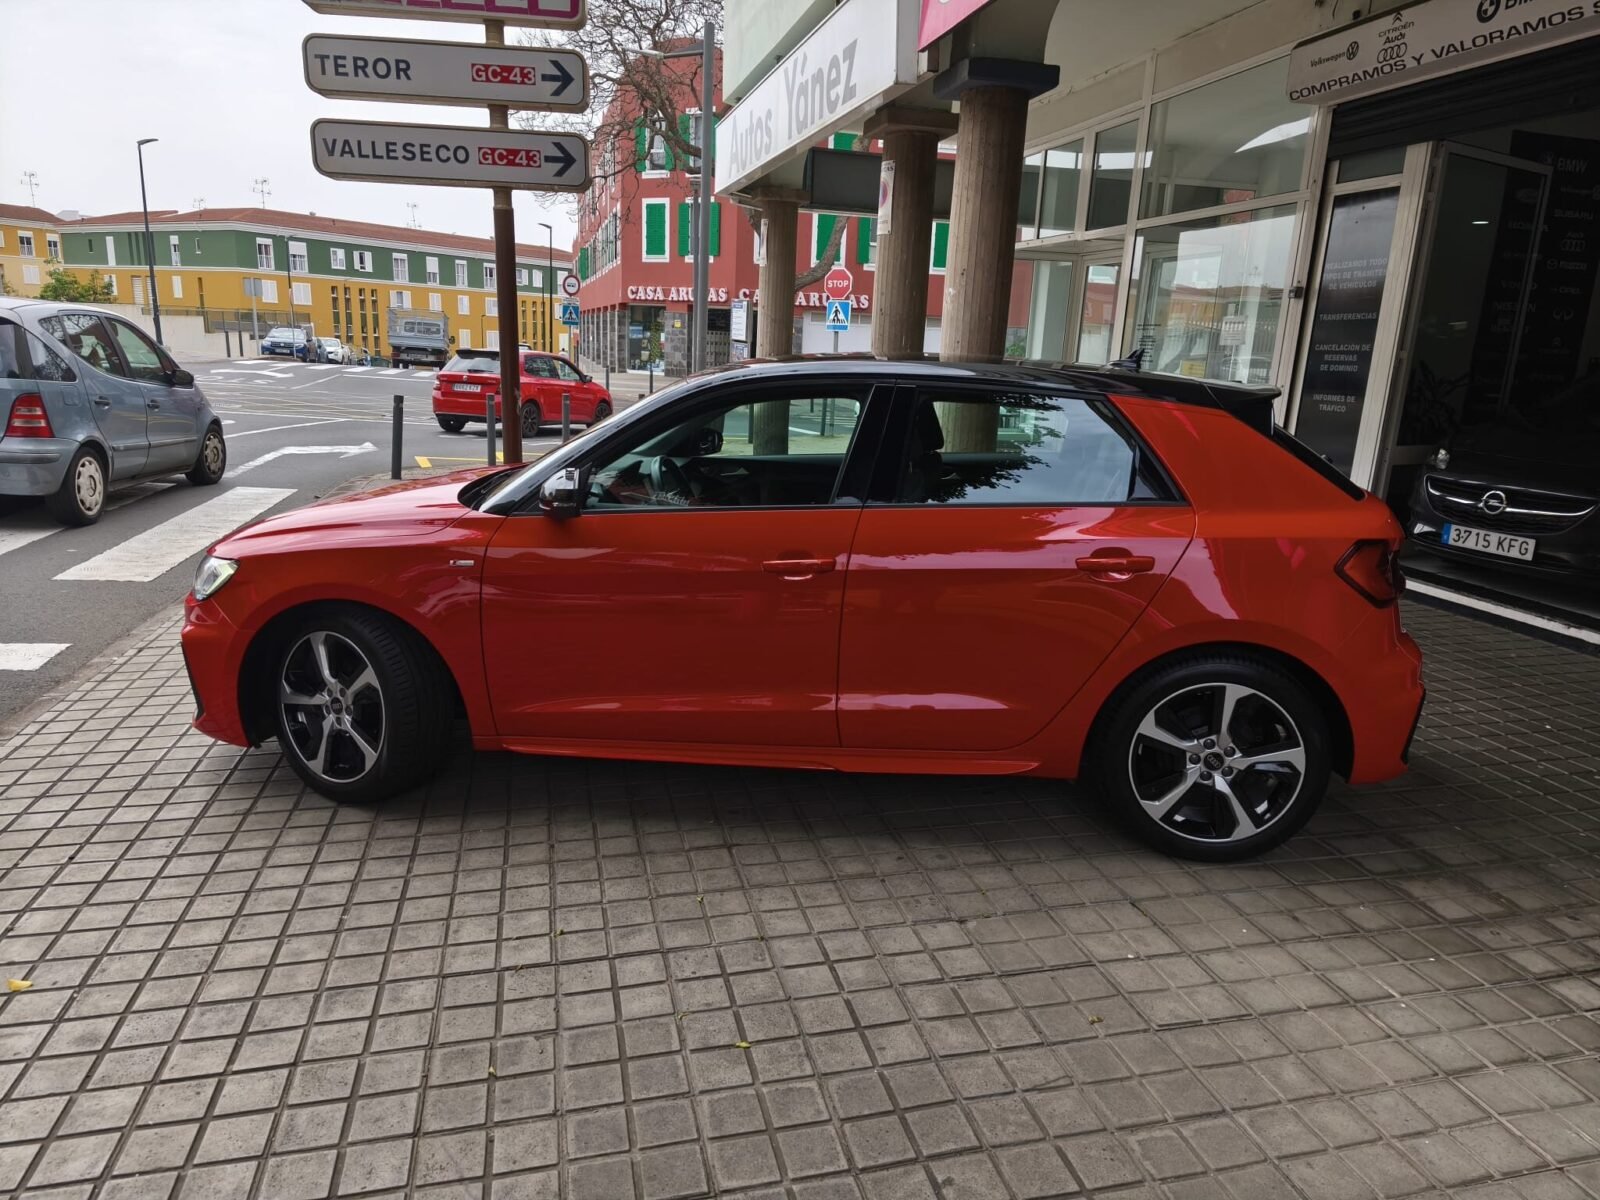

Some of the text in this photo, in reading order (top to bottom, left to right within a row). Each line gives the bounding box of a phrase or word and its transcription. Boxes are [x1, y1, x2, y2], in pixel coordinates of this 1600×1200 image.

[1383, 32, 1406, 45] Audi
[1289, 6, 1584, 101] COMPRAMOS Y VALORAMOS
[314, 53, 536, 85] TEROR GC-43
[728, 38, 859, 179] Autos Yánez
[322, 137, 541, 168] VALLESECO GC-43
[827, 280, 849, 288] STOP
[627, 285, 728, 302] CASA ARUAS
[1319, 311, 1377, 320] TRANSFERENCIAS
[1324, 354, 1358, 362] RESERVAS
[1313, 393, 1345, 402] INFORMES
[1452, 528, 1530, 556] 3715 KFG
